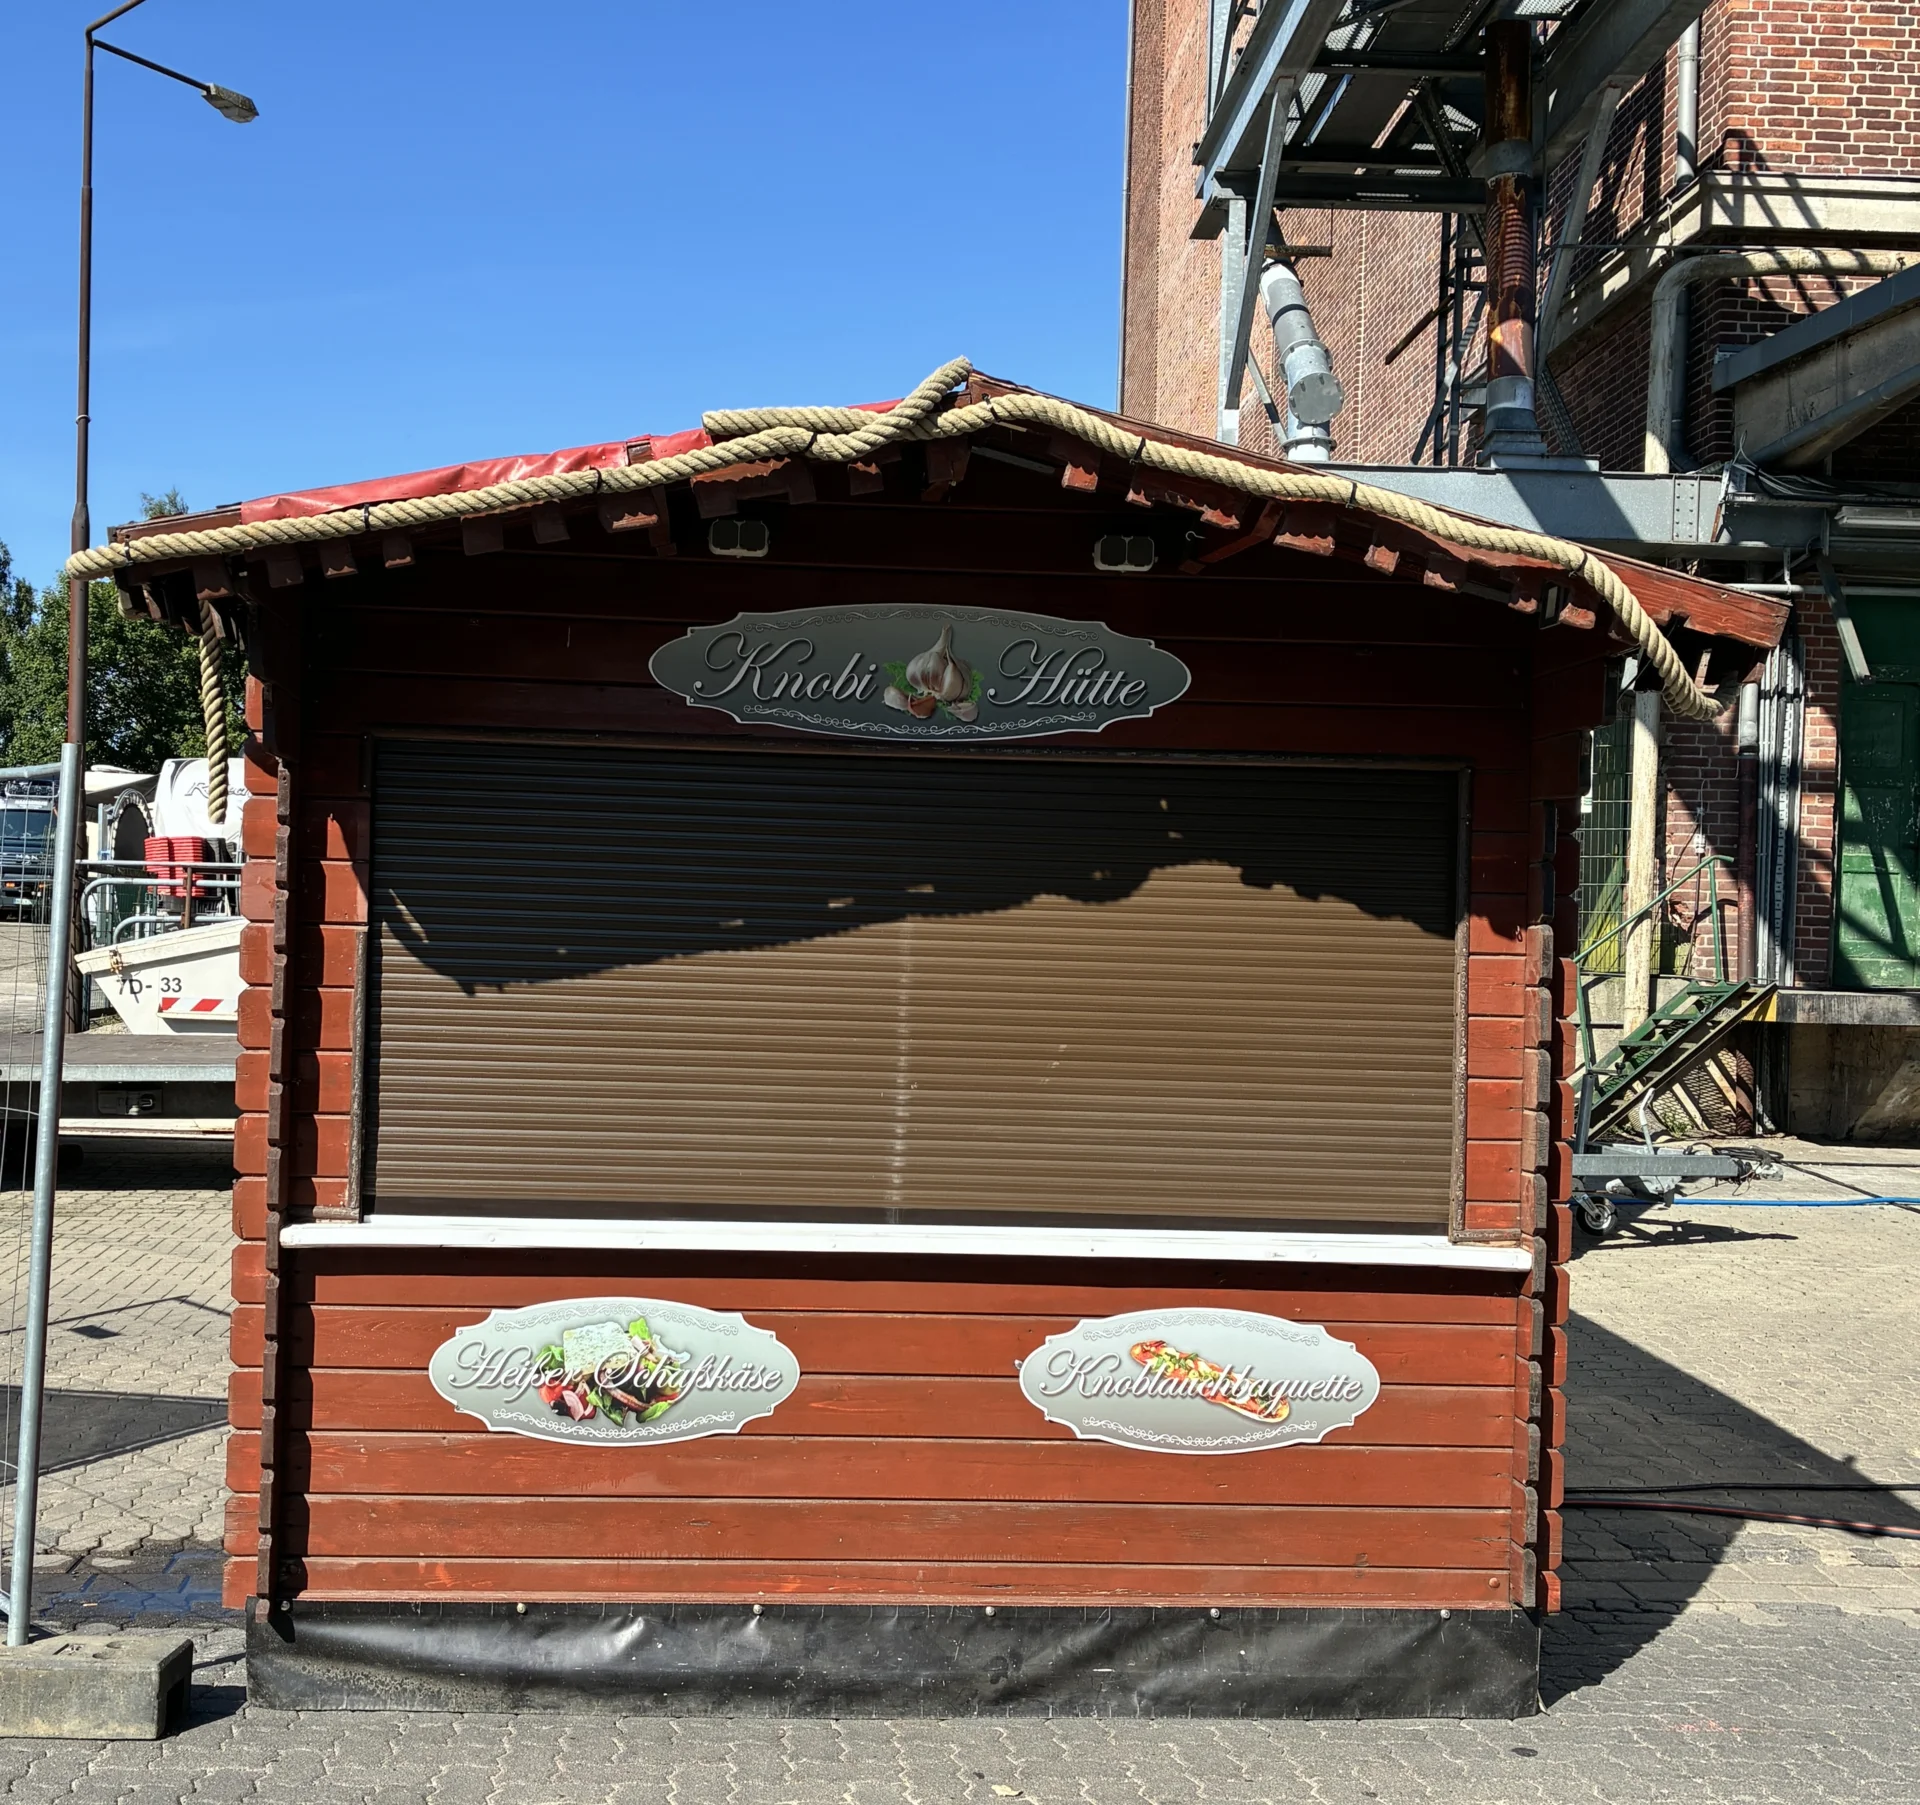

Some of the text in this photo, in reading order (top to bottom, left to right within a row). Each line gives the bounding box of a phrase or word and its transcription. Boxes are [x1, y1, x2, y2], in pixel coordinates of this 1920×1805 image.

[694, 630, 1148, 707] Knobi Hütte
[448, 1340, 783, 1401] Heißer Schafskäse
[1039, 1348, 1363, 1414] Knoblauchbaguette
